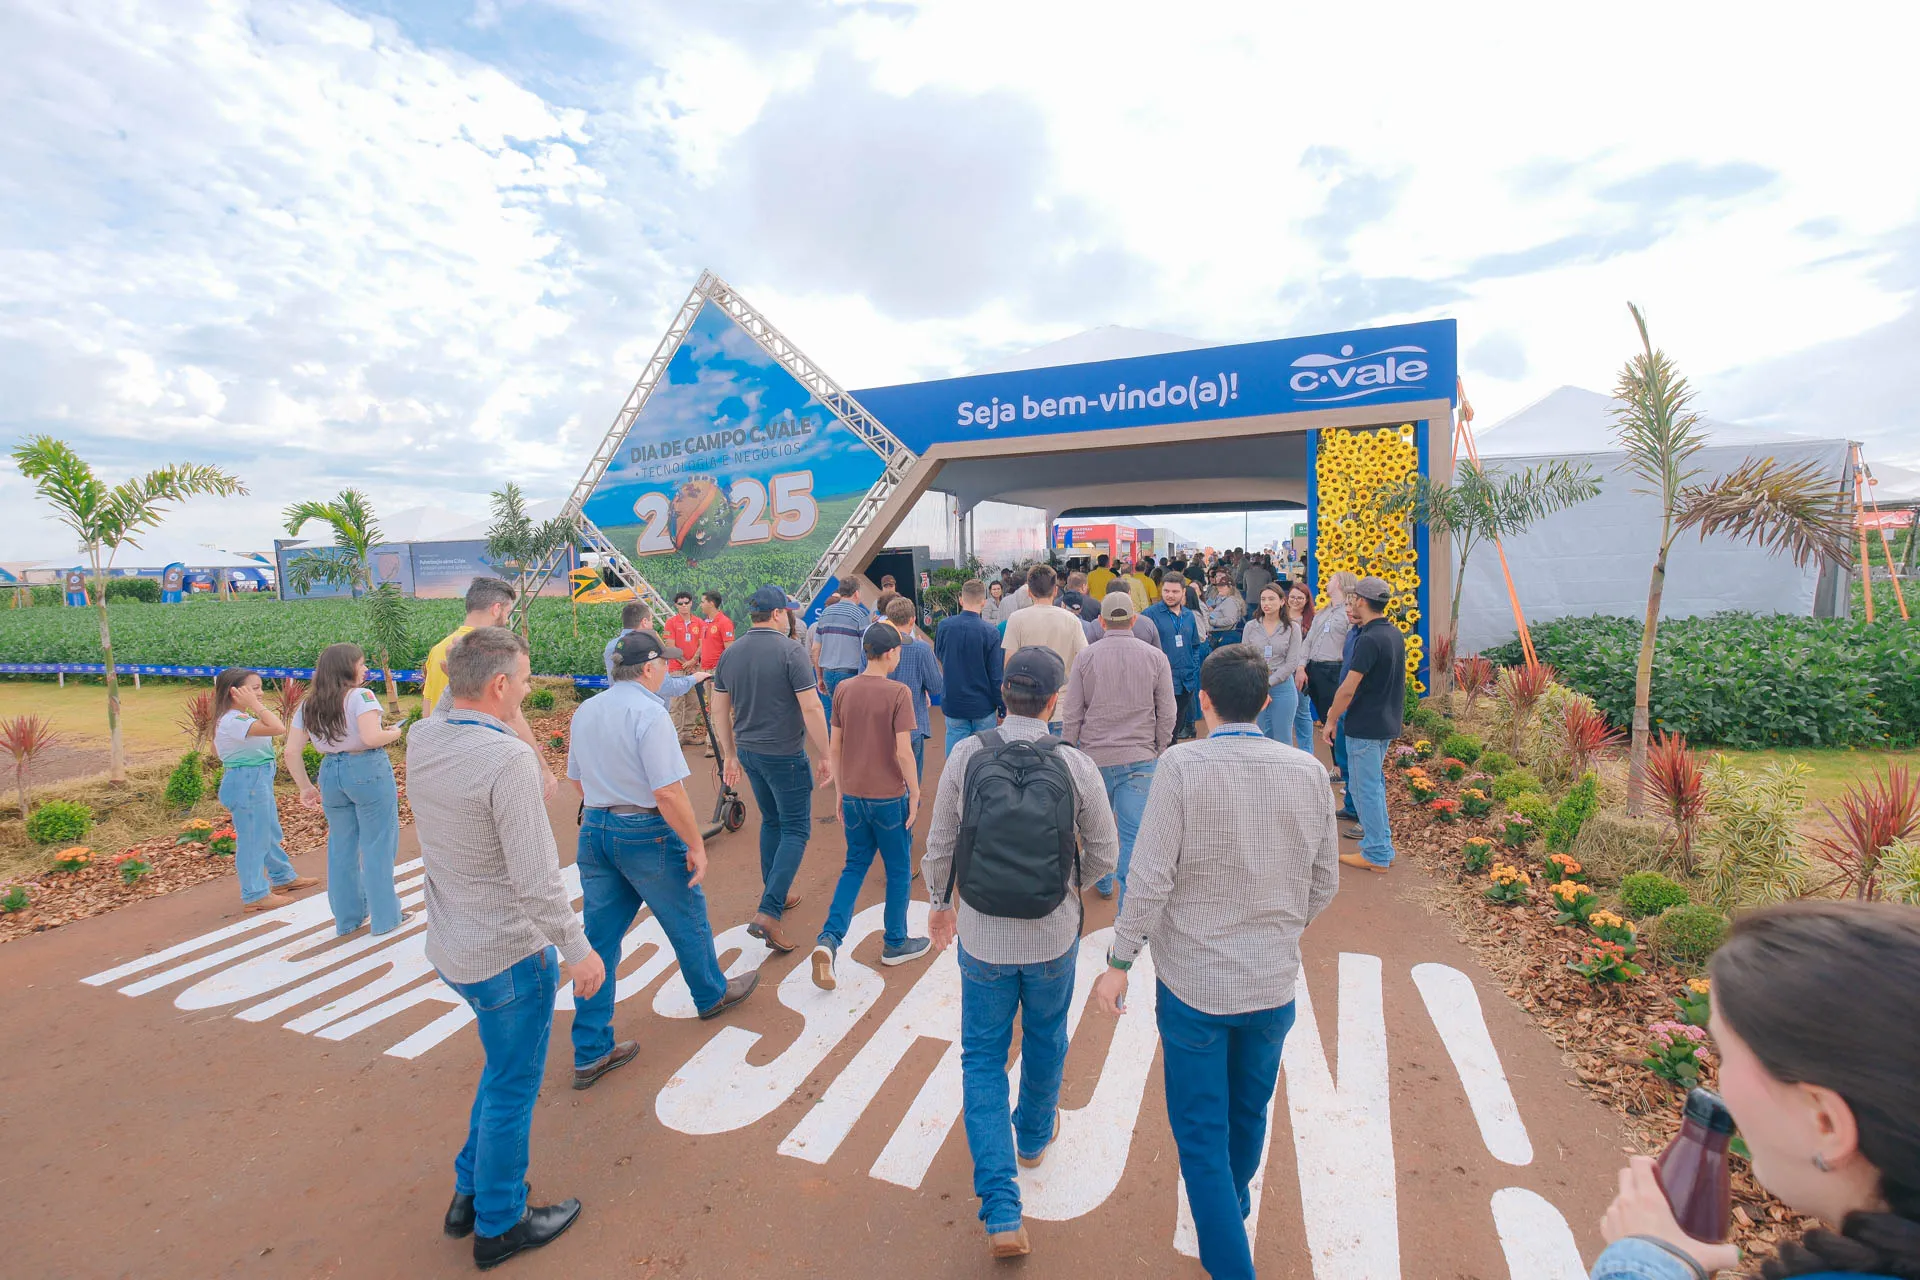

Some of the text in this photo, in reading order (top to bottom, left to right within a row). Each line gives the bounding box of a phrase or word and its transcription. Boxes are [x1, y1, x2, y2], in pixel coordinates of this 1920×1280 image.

[957, 372, 1240, 430] Seja bem-vindo(a)!
[631, 417, 812, 464] DIA DE CAMPO C.VALE
[642, 442, 801, 479] TECNOLOGIA E NEGÓCIOS
